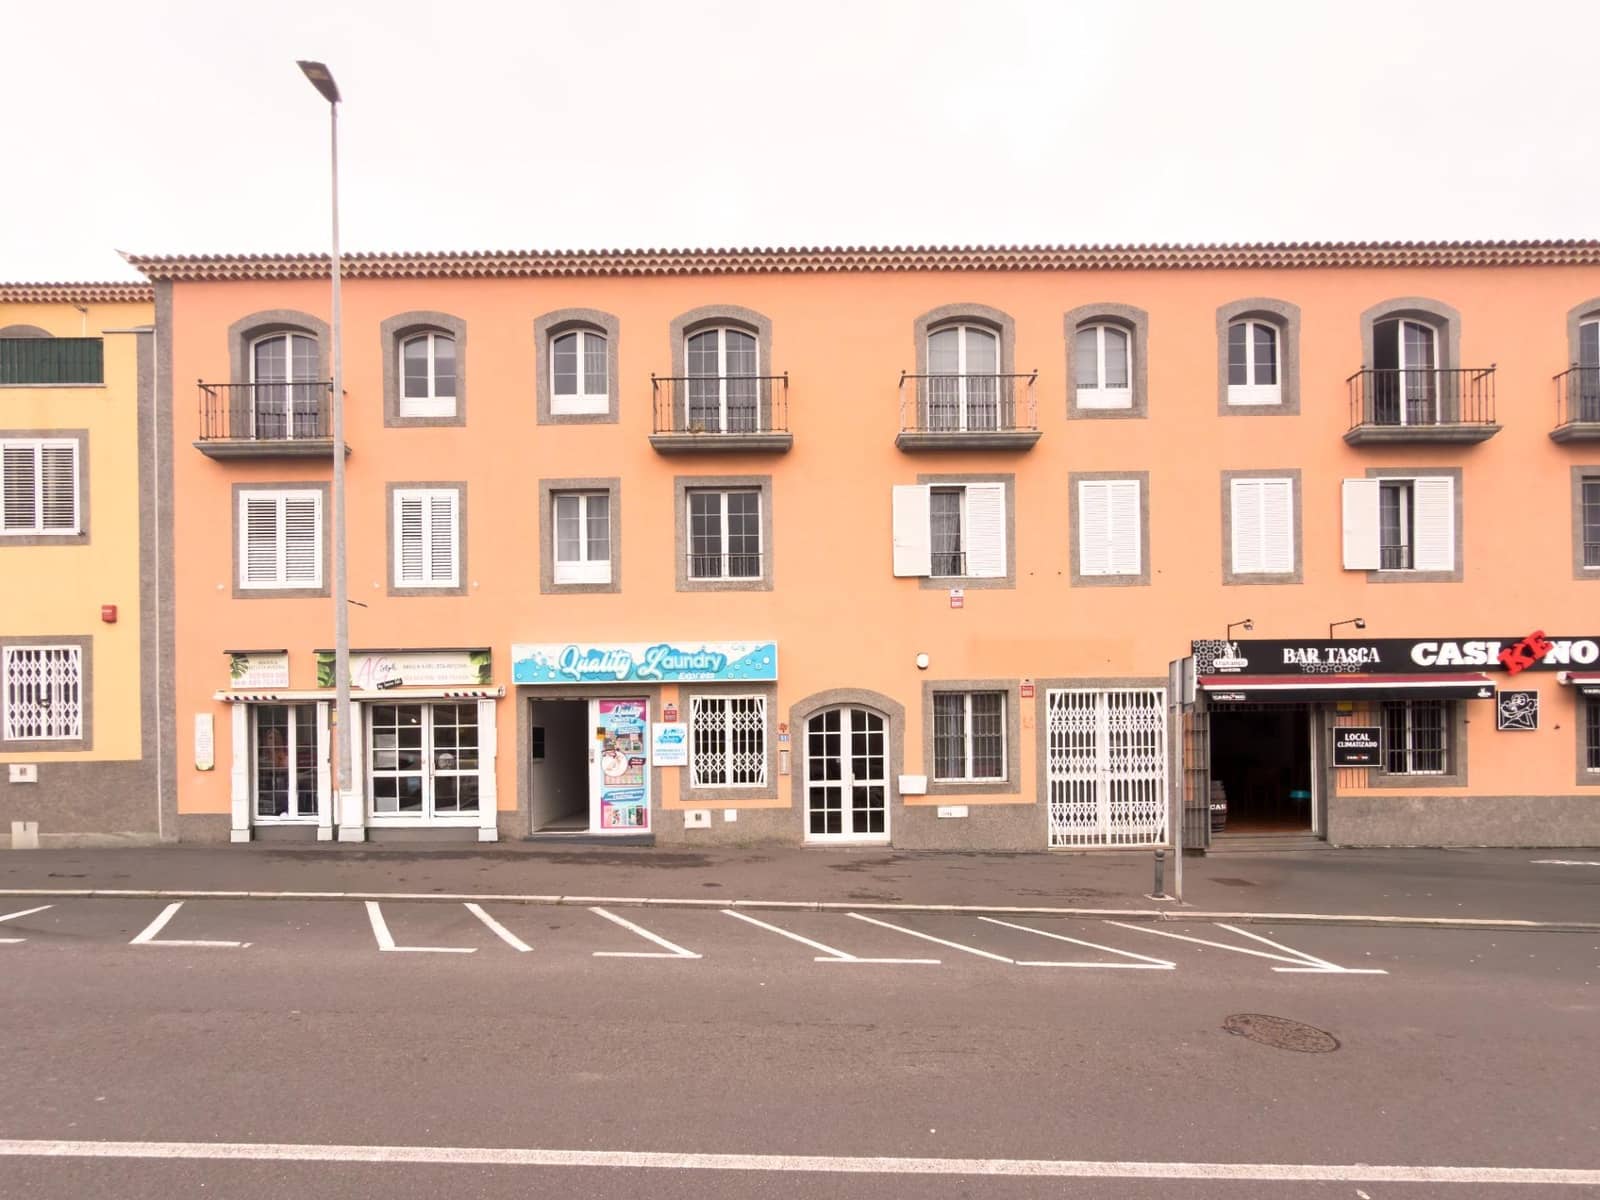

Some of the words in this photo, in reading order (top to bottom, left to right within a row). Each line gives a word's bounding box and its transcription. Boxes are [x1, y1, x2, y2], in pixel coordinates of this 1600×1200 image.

[560, 645, 632, 681] Quality
[637, 645, 723, 681] Laundry
[1283, 648, 1321, 664] BAR
[1325, 647, 1380, 663] TASCA
[1497, 630, 1553, 676] KE
[1344, 733, 1370, 741] LOCAL
